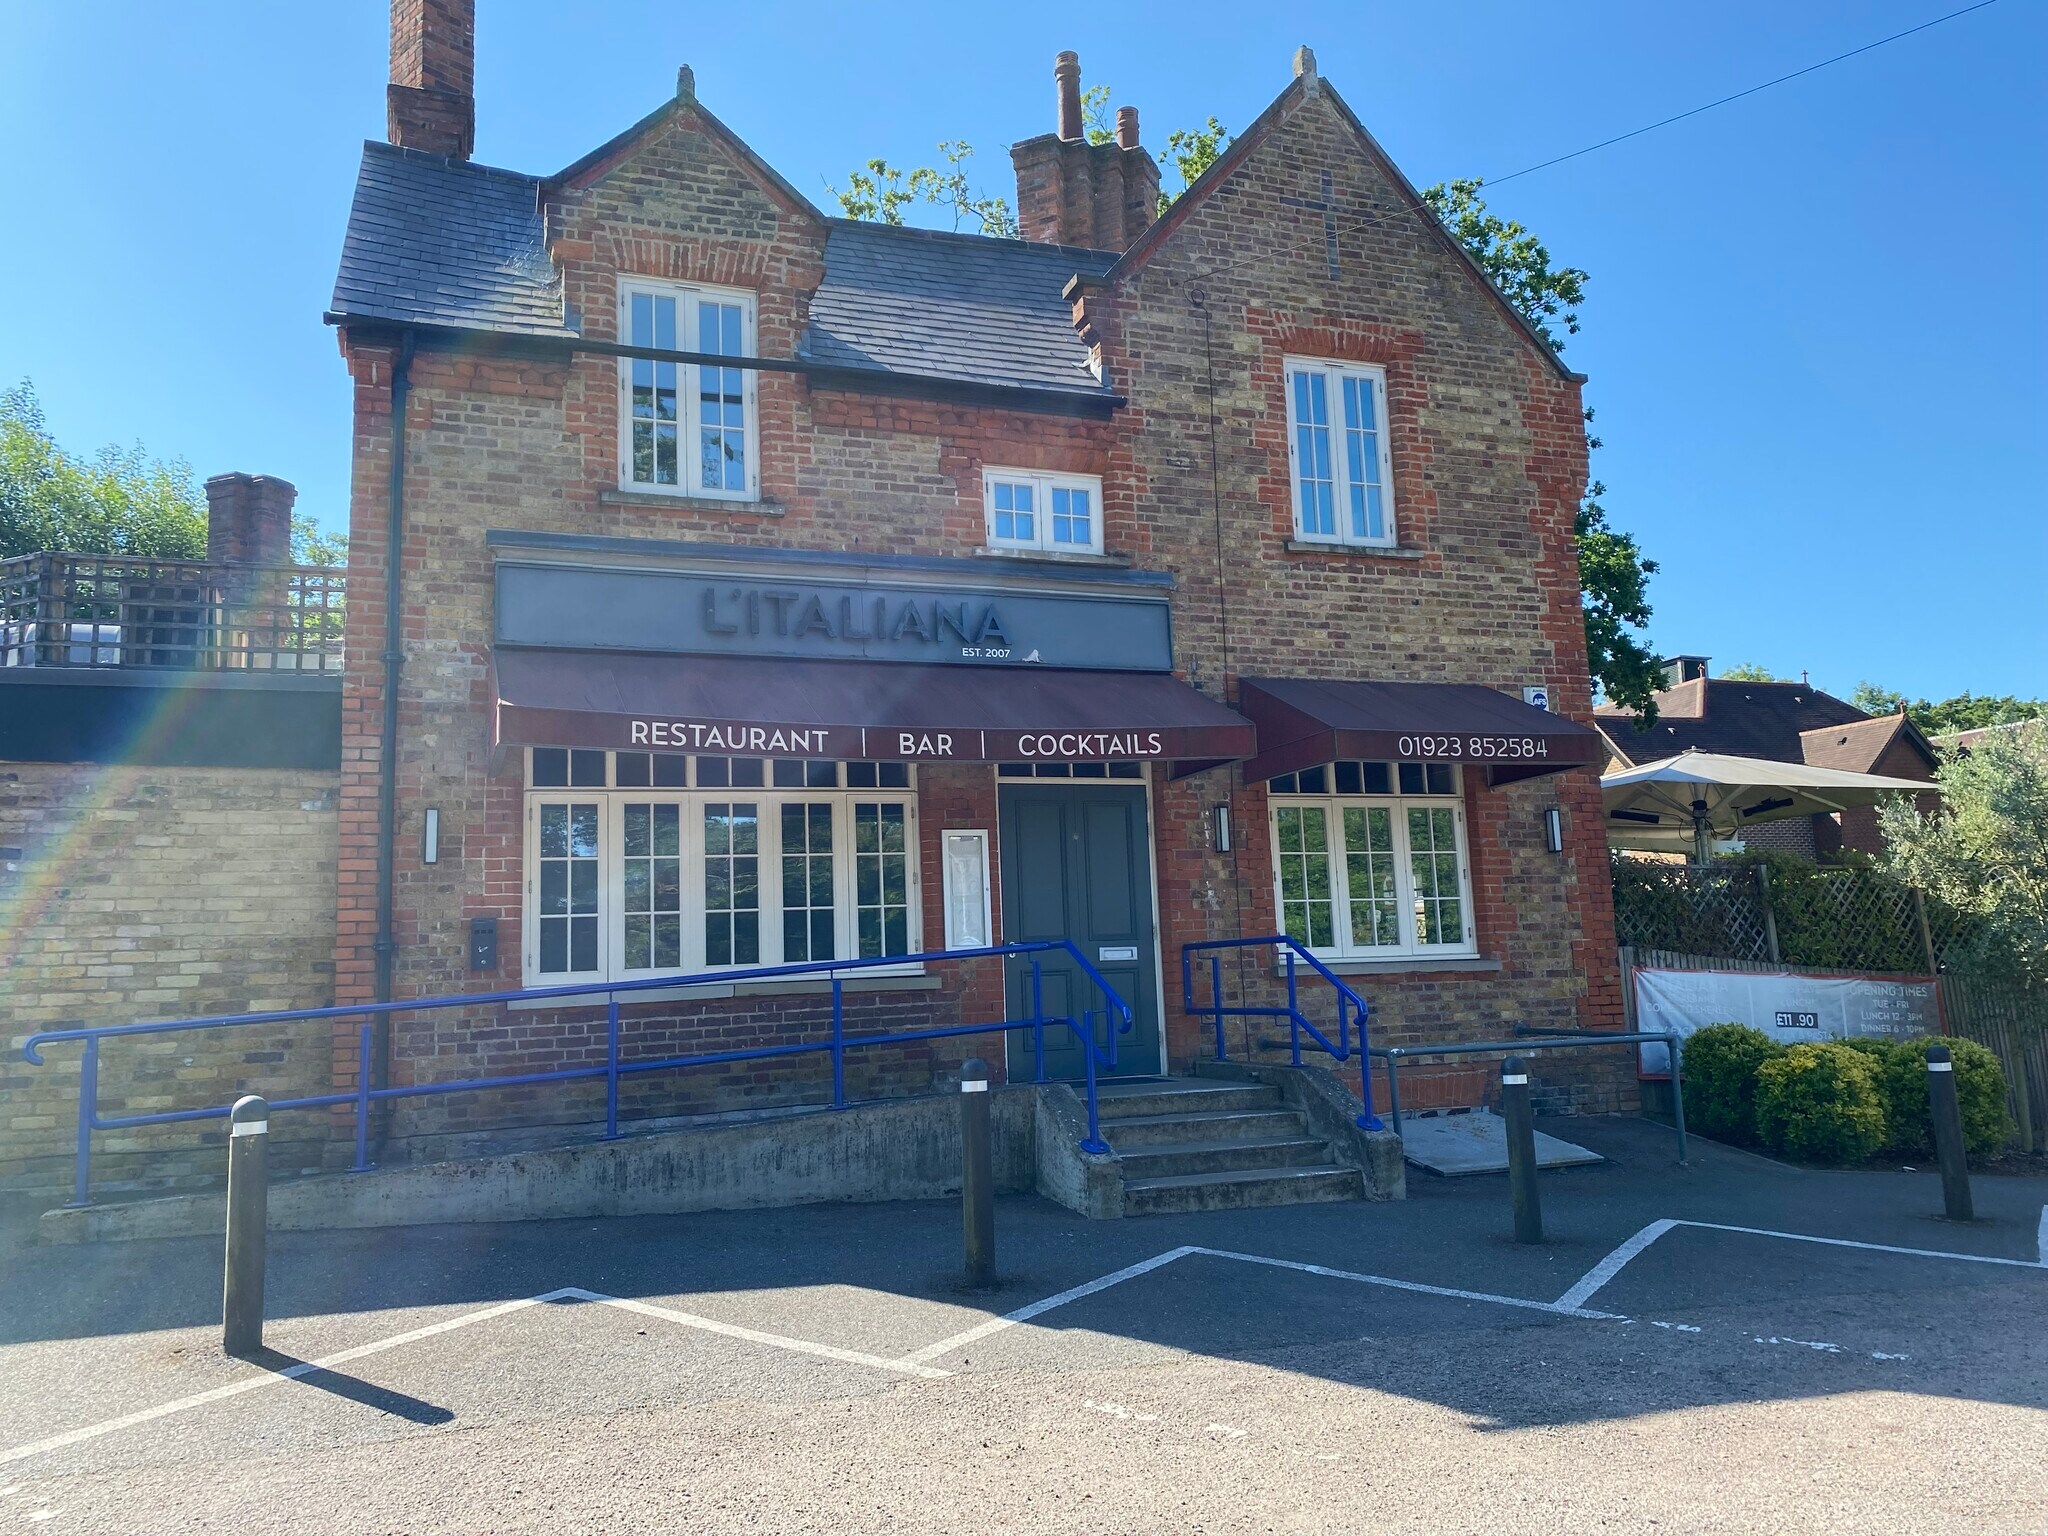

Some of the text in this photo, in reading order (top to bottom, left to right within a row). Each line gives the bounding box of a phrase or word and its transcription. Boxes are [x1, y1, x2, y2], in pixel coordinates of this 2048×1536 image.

[704, 587, 1012, 646] L'ITALIANA
[962, 647, 1011, 658] EST. 2007
[631, 720, 1162, 756] RESTAURANT BAR COCKTAILS
[1398, 736, 1548, 758] 01923 852584
[1849, 984, 1927, 997] OPENING TIMES
[1873, 999, 1889, 1008] TUE
[1896, 1000, 1909, 1009] FRI
[1776, 1013, 1793, 1026] £11
[1861, 1011, 1889, 1021] LUNCH
[1892, 1012, 1900, 1021] 12
[1907, 1012, 1923, 1021] 3PM
[1861, 1024, 1891, 1033] DINNER
[1893, 1025, 1899, 1033] 6
[1906, 1025, 1925, 1033] 10PM
